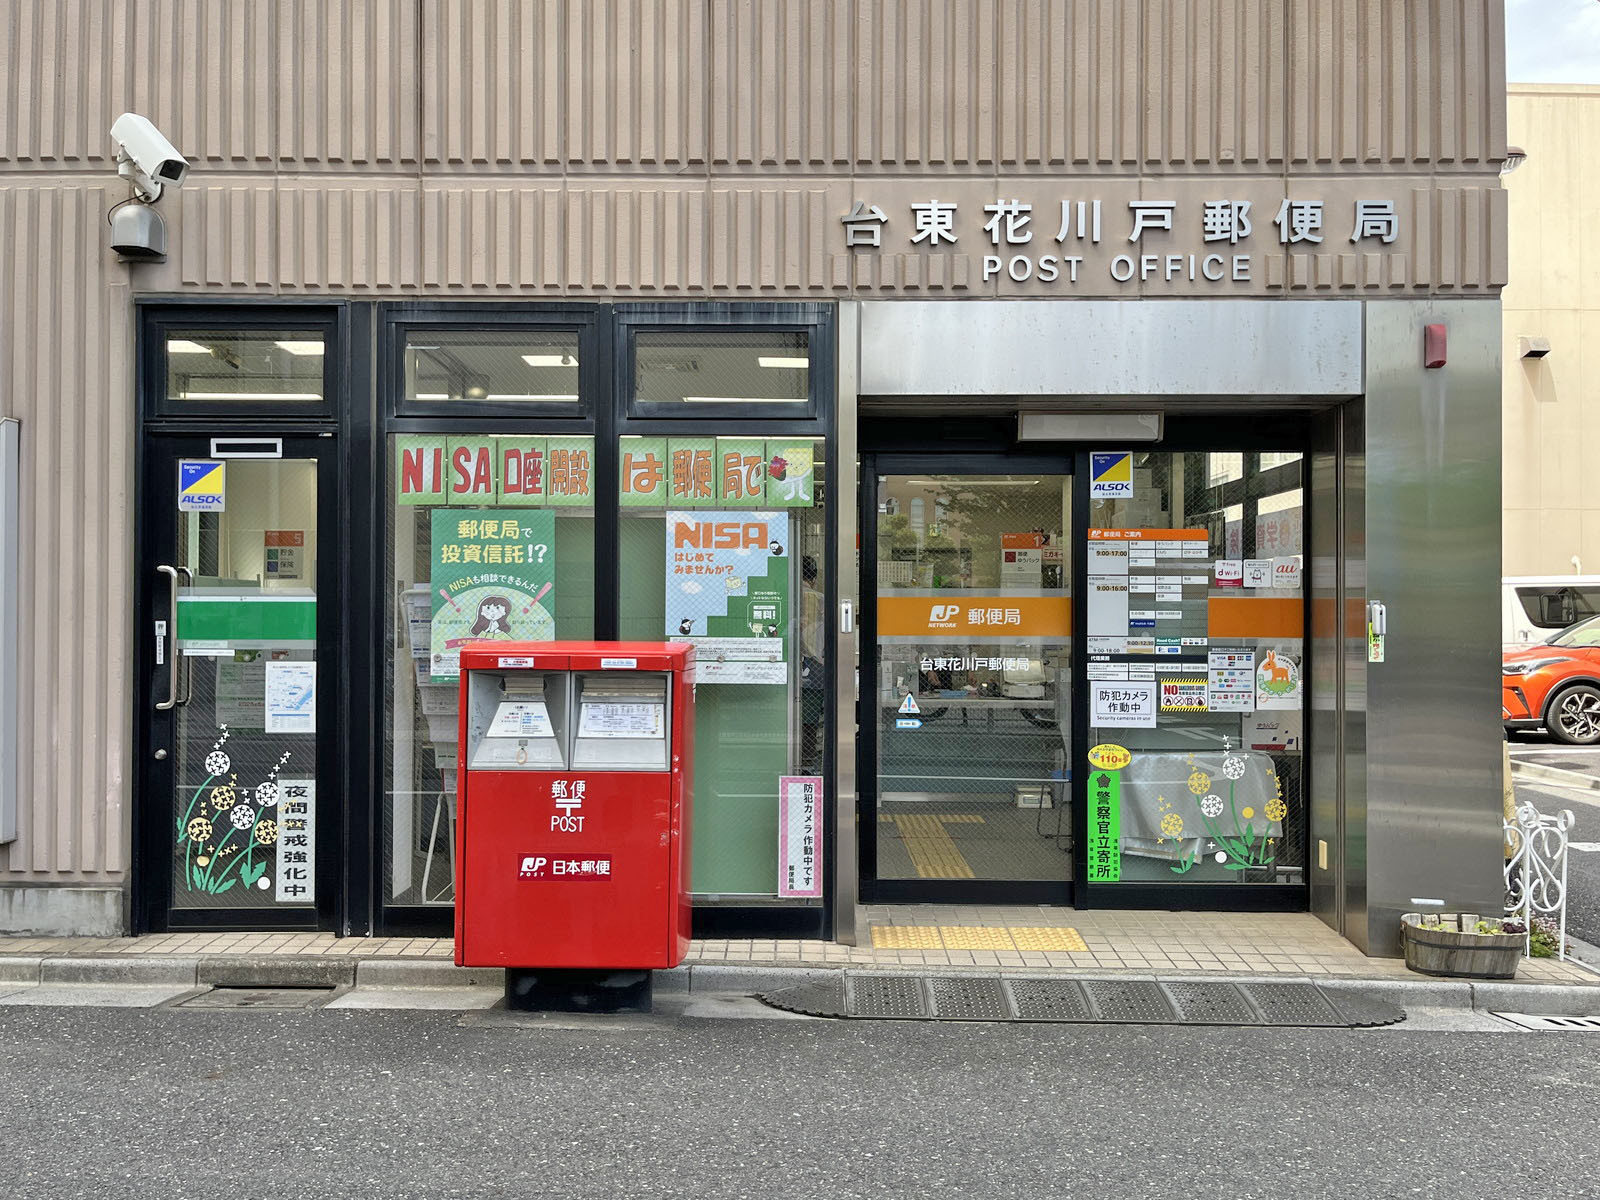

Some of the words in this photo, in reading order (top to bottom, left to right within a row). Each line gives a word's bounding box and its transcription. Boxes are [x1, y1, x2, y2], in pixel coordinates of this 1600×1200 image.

[841, 199, 1398, 246] 台東花川戸郵便局
[983, 255, 1083, 282] POST
[1110, 255, 1251, 282] OFFICE
[401, 446, 590, 497] NISA口座開設
[621, 448, 763, 500] は郵便局で
[1093, 483, 1130, 491] ALSOK
[181, 495, 222, 504] ALSOK
[457, 519, 533, 540] 郵便局で
[674, 522, 769, 549] NISA
[674, 552, 714, 562] はじめて
[674, 565, 734, 575] みませんか?
[1276, 565, 1297, 574] au
[448, 573, 539, 593] NISAも相談できるんだ
[968, 608, 1021, 626] 郵便局
[920, 657, 1030, 672] 台東花川戸郵便局
[1100, 690, 1148, 701] 防犯カメラ
[1164, 684, 1178, 696] NO
[1108, 702, 1141, 712] 作動中
[551, 780, 586, 800] 郵便
[551, 816, 585, 832] POST
[283, 785, 309, 897] 夜間警戒強化中
[803, 784, 814, 886] 防犯カメラ作動中です
[1096, 791, 1111, 878] 警察官立寄所
[552, 860, 610, 875] 日本郵便
